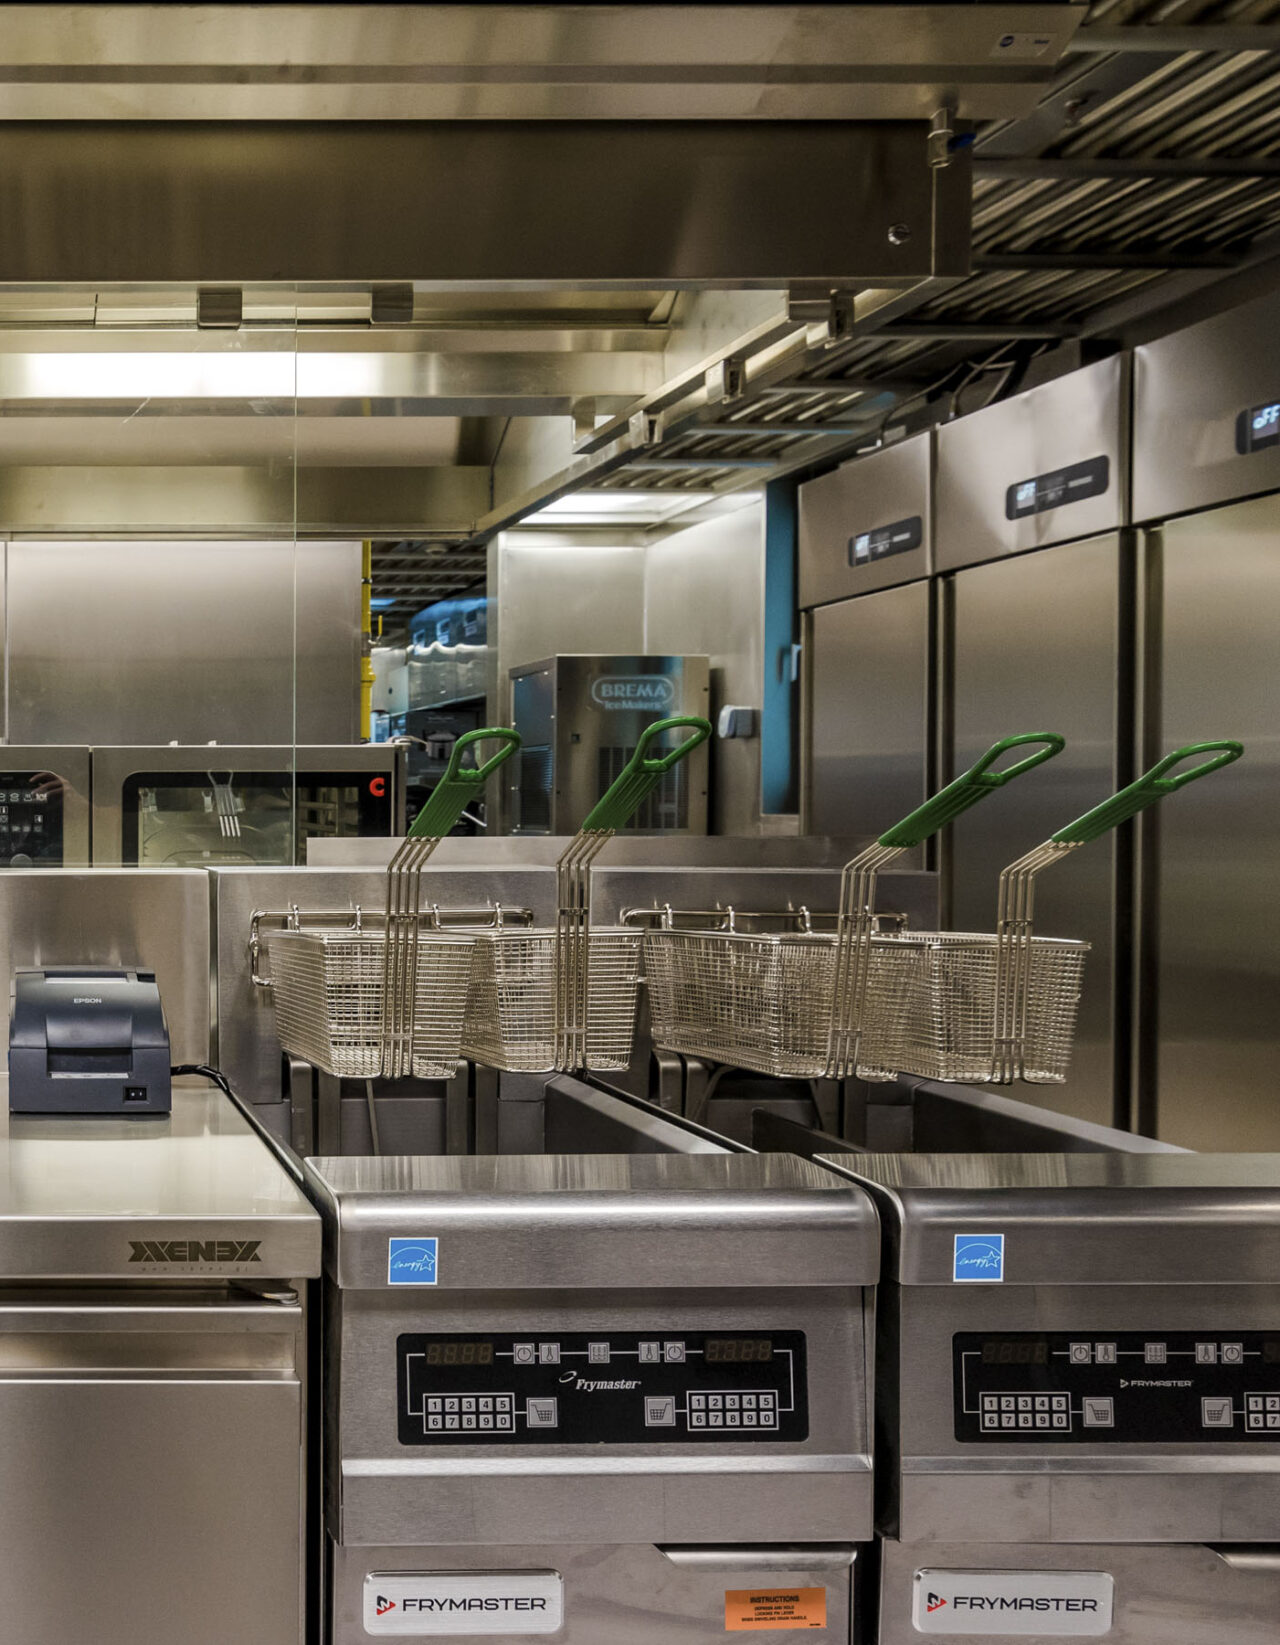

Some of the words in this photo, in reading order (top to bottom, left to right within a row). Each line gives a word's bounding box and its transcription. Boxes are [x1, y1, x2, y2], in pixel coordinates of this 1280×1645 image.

[601, 683, 666, 697] BREMA
[576, 1379, 637, 1392] Frymaster
[402, 1597, 547, 1612] FRYMASTER
[749, 1596, 800, 1604] INSTRUCTIONS
[953, 1596, 1098, 1612] FRYMASTER
